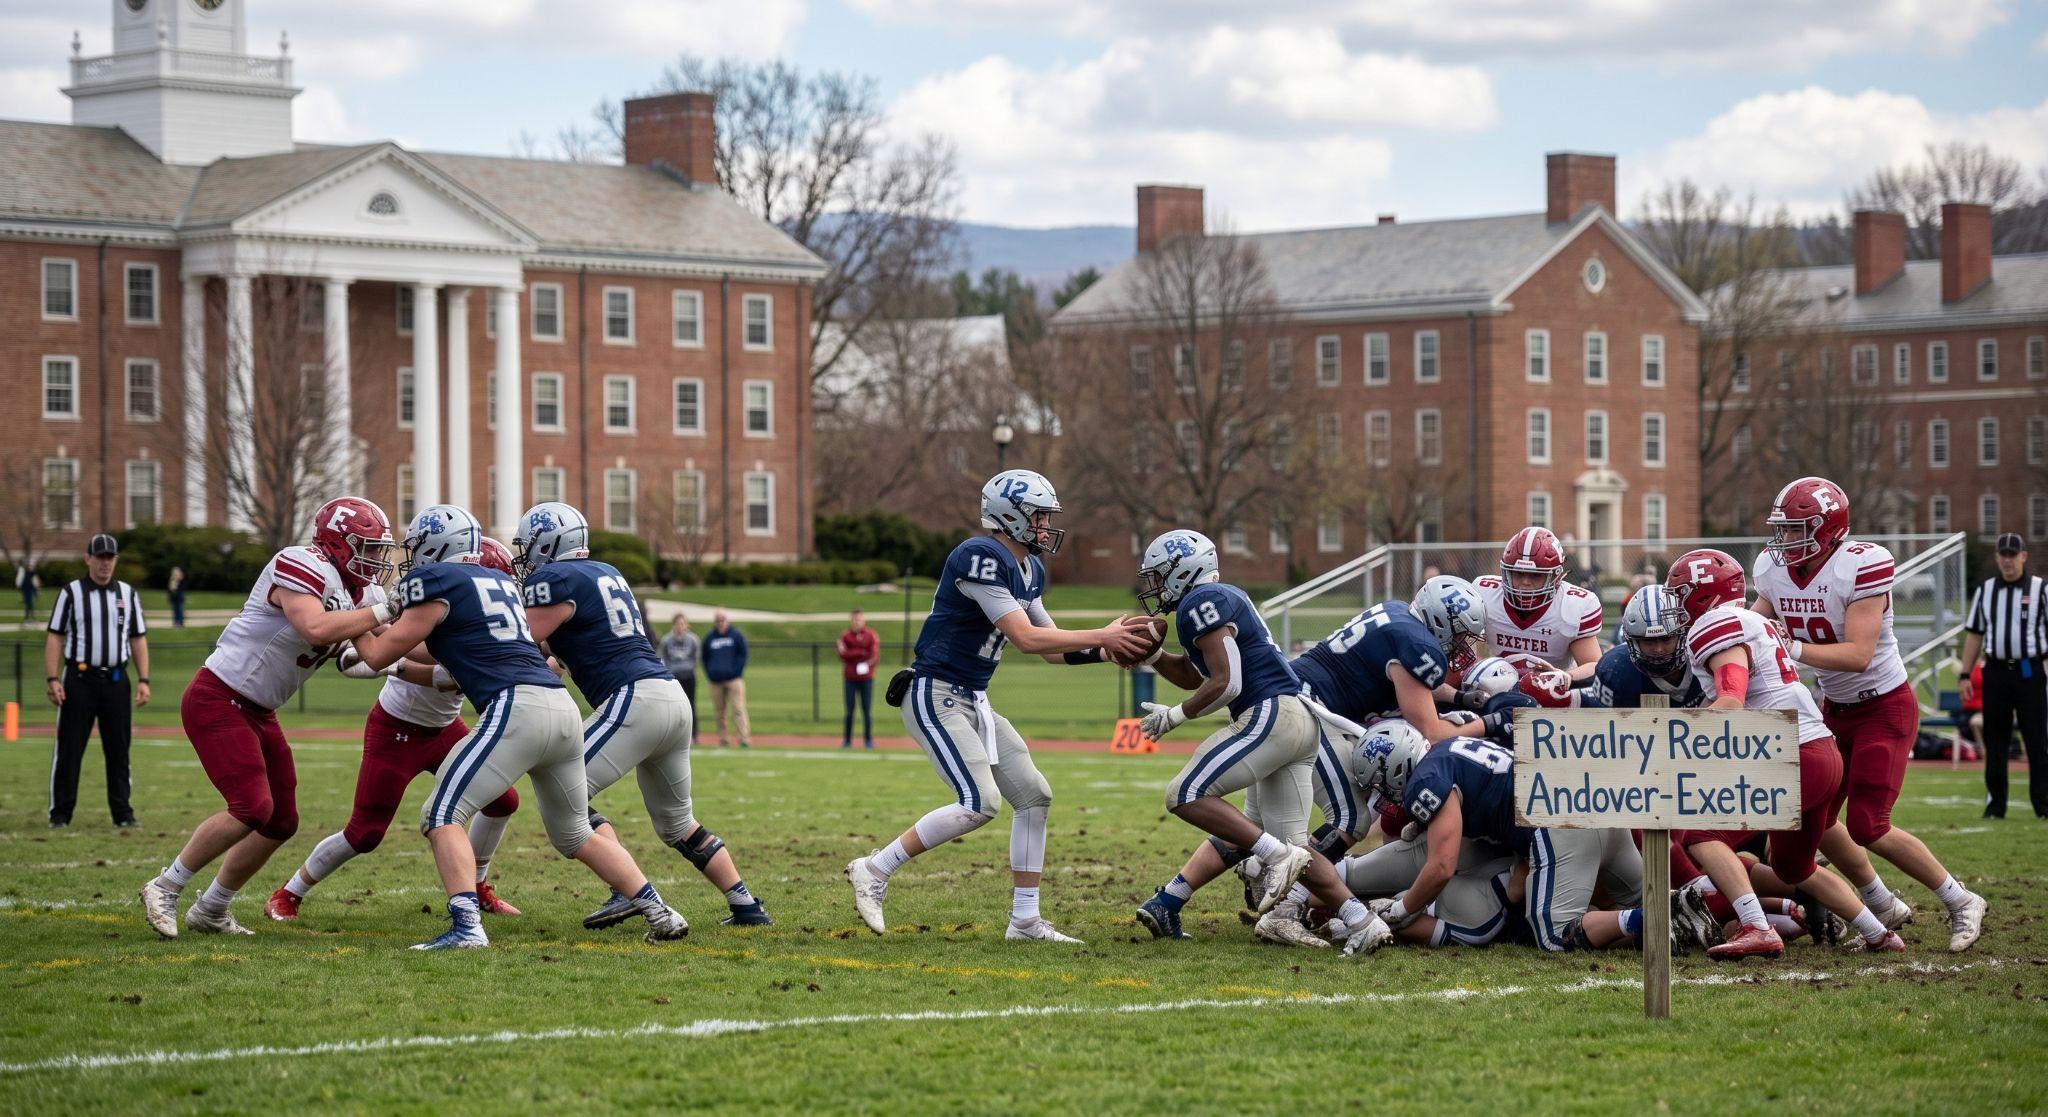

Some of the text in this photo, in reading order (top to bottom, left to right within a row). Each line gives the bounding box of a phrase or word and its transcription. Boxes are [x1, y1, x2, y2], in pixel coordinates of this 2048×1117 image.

[1000, 479, 1029, 502] 12
[1811, 487, 1840, 514] E
[326, 505, 357, 533] E
[967, 554, 999, 581] 12
[1687, 558, 1715, 584] E
[1779, 597, 1827, 614] EXETER
[1496, 633, 1549, 653] EXETER
[1116, 724, 1141, 749] 20
[1532, 718, 1783, 775] Rivalry Redux:
[1411, 788, 1442, 824] 83
[1525, 772, 1788, 816] Andover-Exeter
